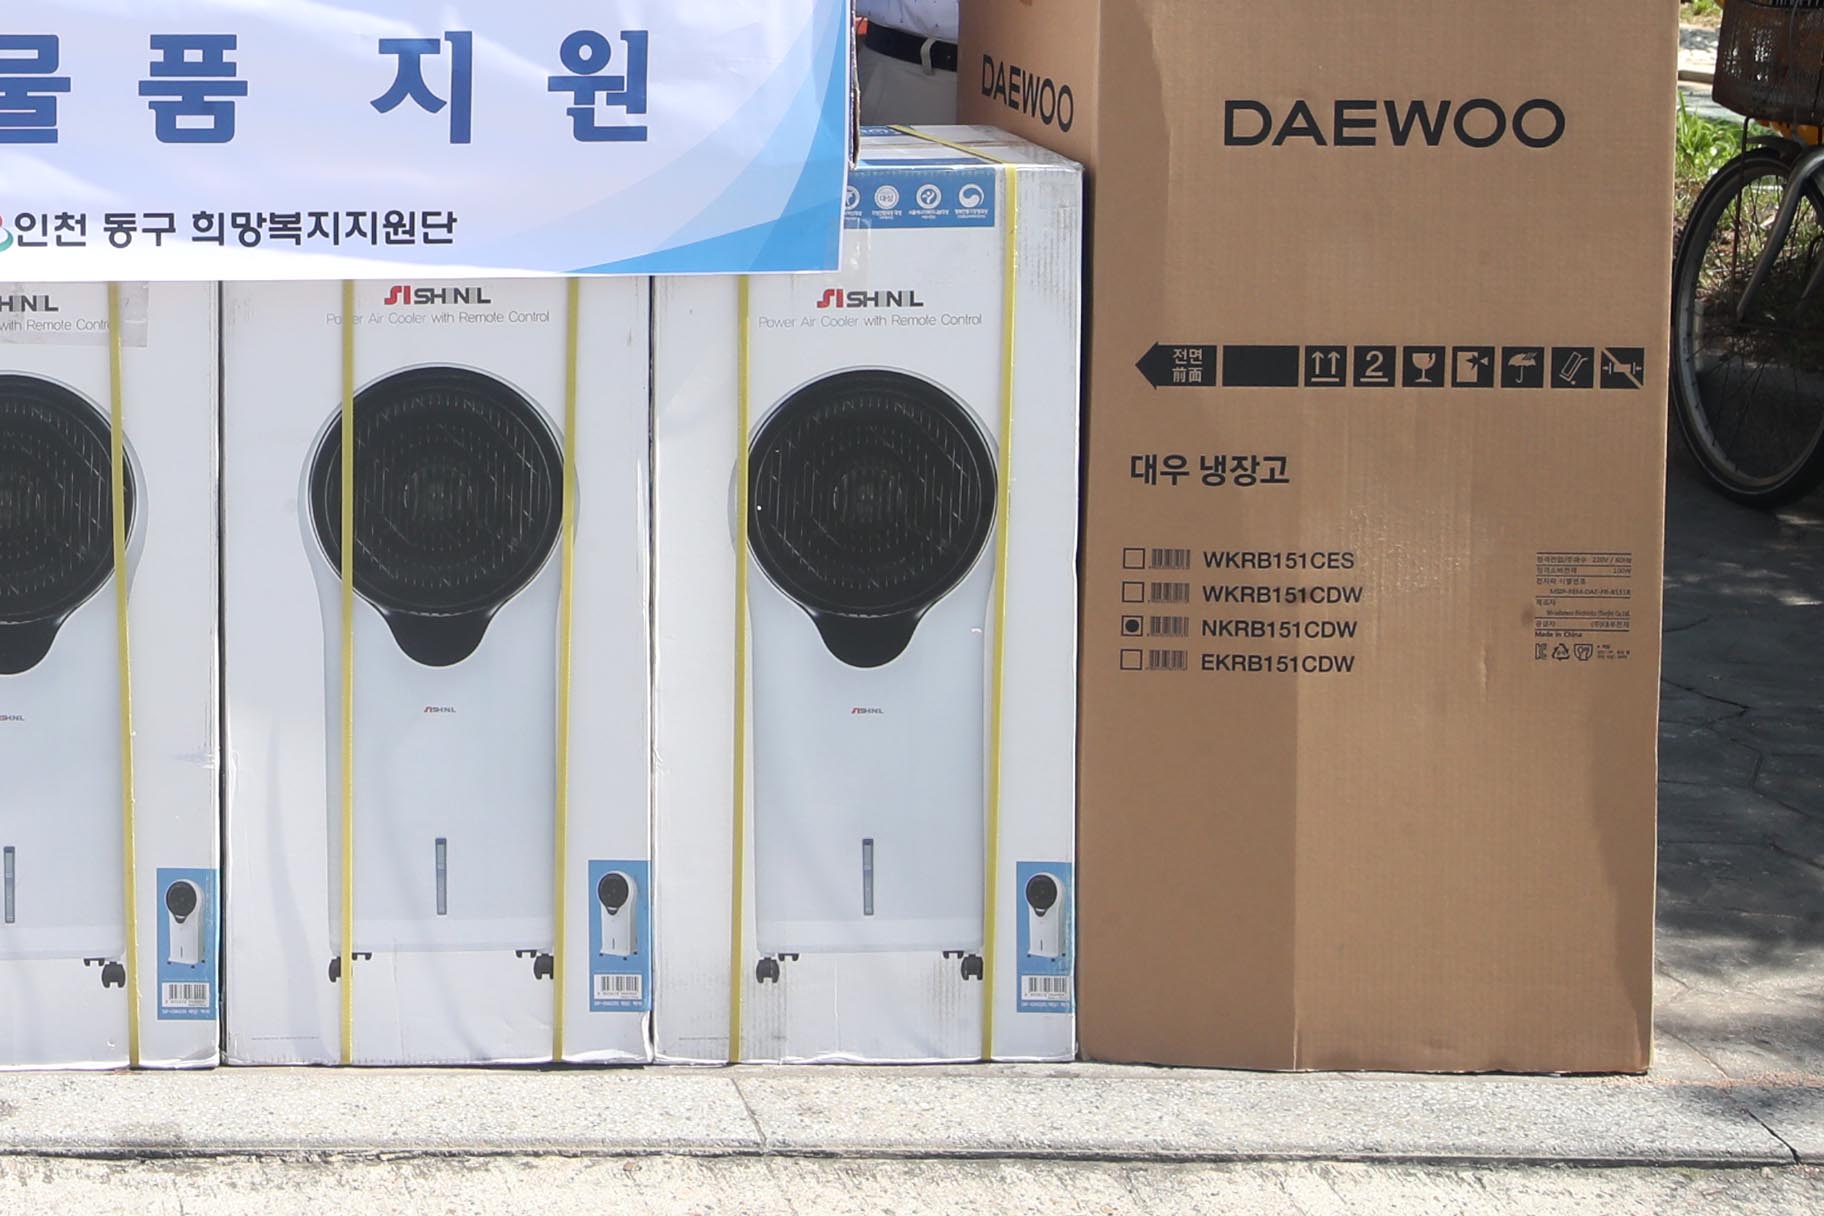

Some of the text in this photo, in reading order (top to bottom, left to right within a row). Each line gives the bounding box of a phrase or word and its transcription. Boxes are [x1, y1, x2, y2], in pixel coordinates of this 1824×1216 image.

[981, 53, 1074, 133] DAEWOO
[1224, 98, 1566, 148] DAEWOO
[14, 208, 458, 249] 인천 동구 희망복지지원단
[0, 319, 23, 331] with
[27, 319, 72, 332] Remote
[76, 318, 112, 331] Contro
[326, 311, 550, 325] Poer Air Cooler with Remote Control
[758, 314, 982, 329] Power Air Cooler with Remote Control
[1172, 348, 1203, 365] 전면
[1365, 350, 1384, 377] 2
[1171, 366, 1203, 383] 前面
[1130, 453, 1291, 487] 대우 냉장고
[1203, 551, 1355, 570] WKRB151CES
[1202, 585, 1363, 604] WKRB151CDW
[1202, 619, 1357, 638] NKRB151CDW
[1201, 653, 1355, 673] EKRB151CDW
